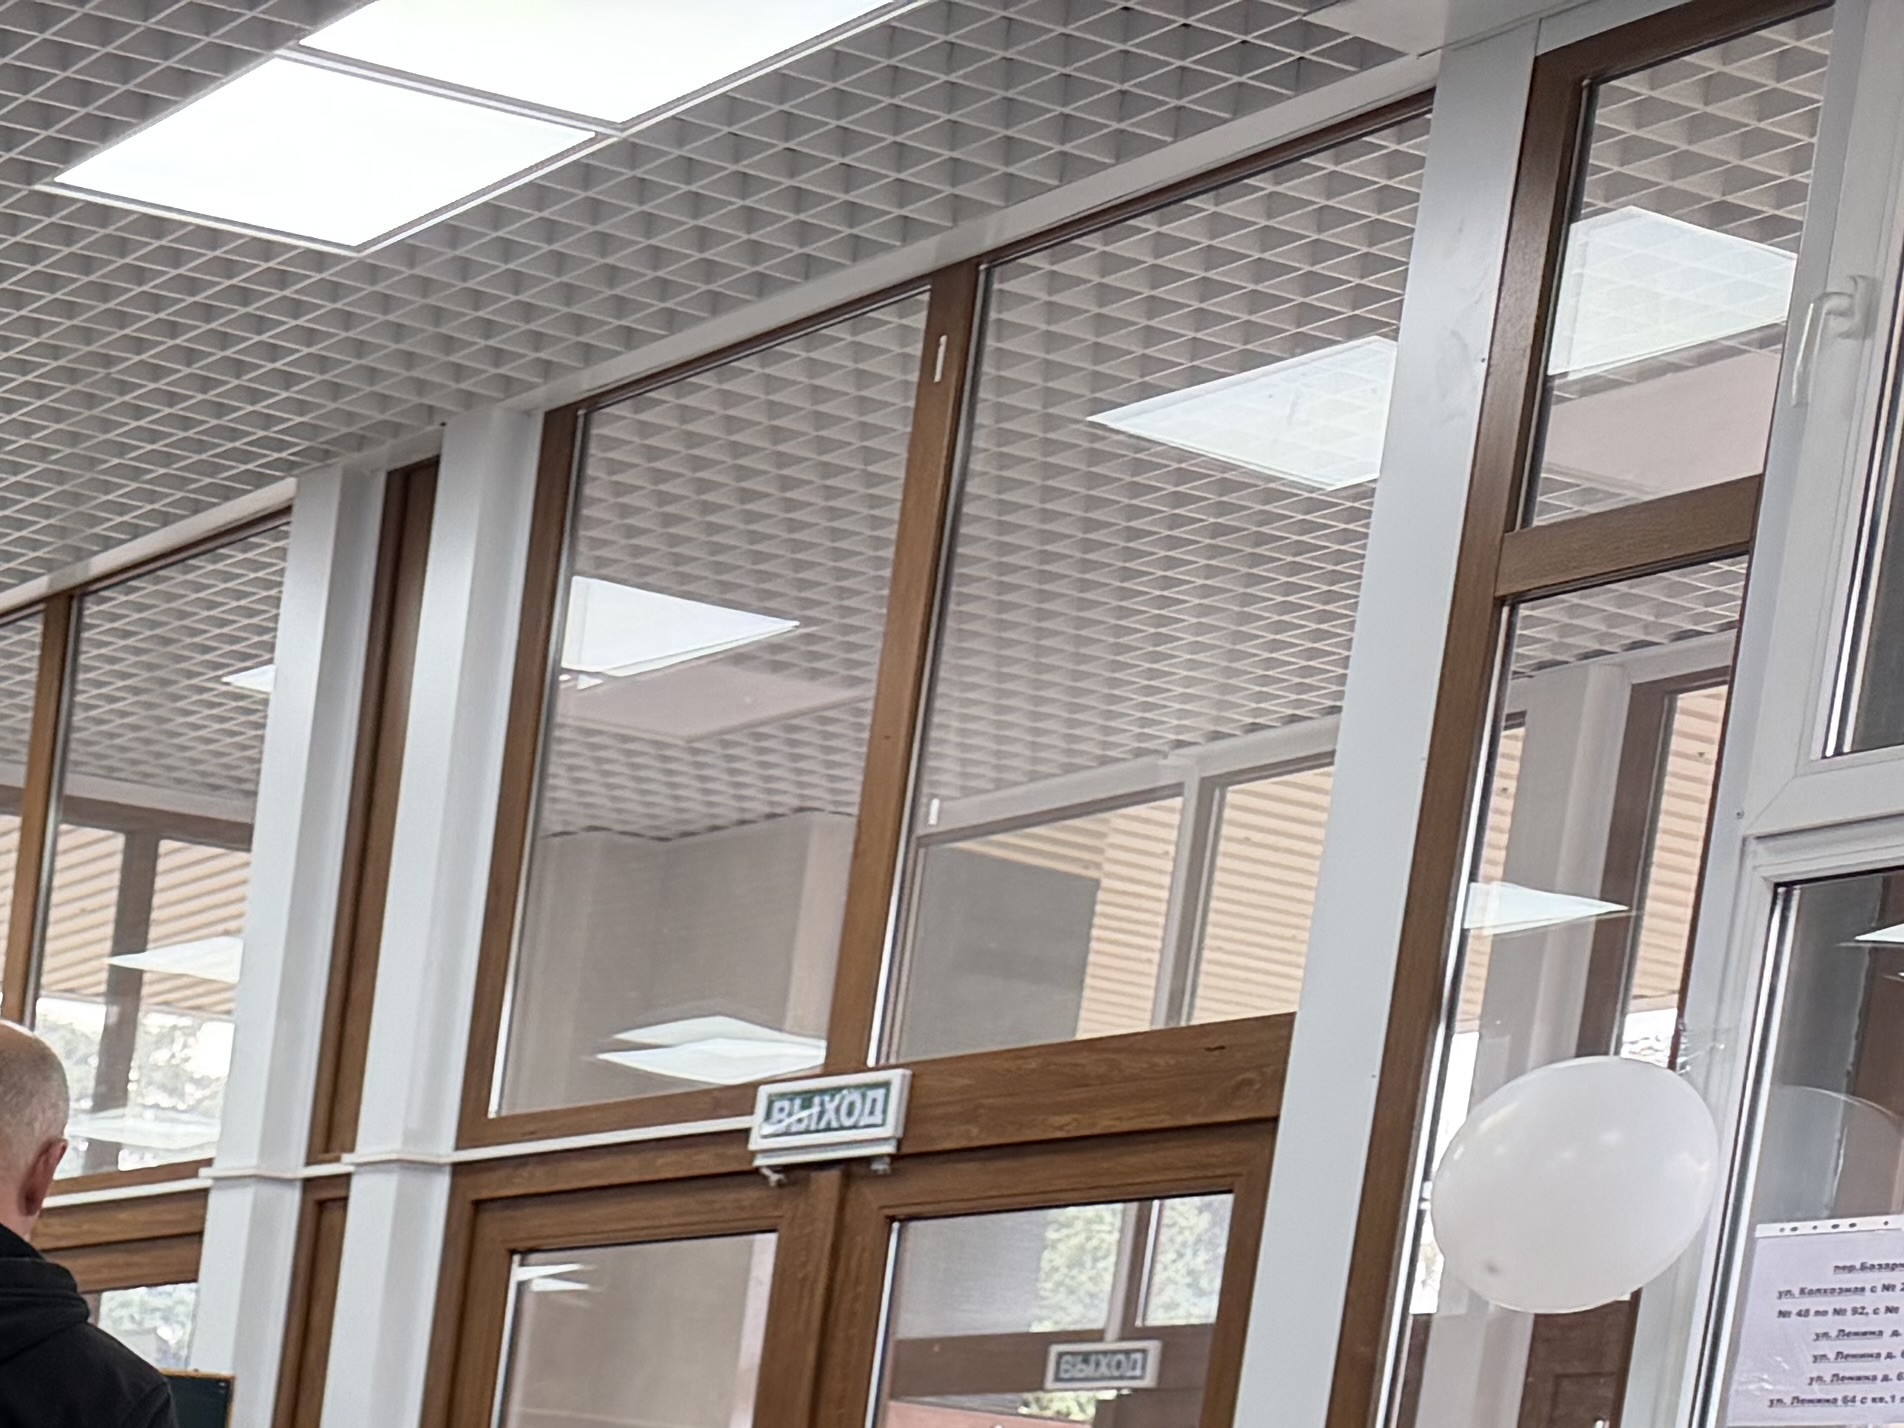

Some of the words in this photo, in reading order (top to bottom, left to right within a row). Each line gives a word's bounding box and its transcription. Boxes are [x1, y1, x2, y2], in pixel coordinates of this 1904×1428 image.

[771, 1088, 886, 1131] ВЫХОД
[1872, 1307, 1880, 1315] с
[1059, 1352, 1144, 1378] ВЫХОД
